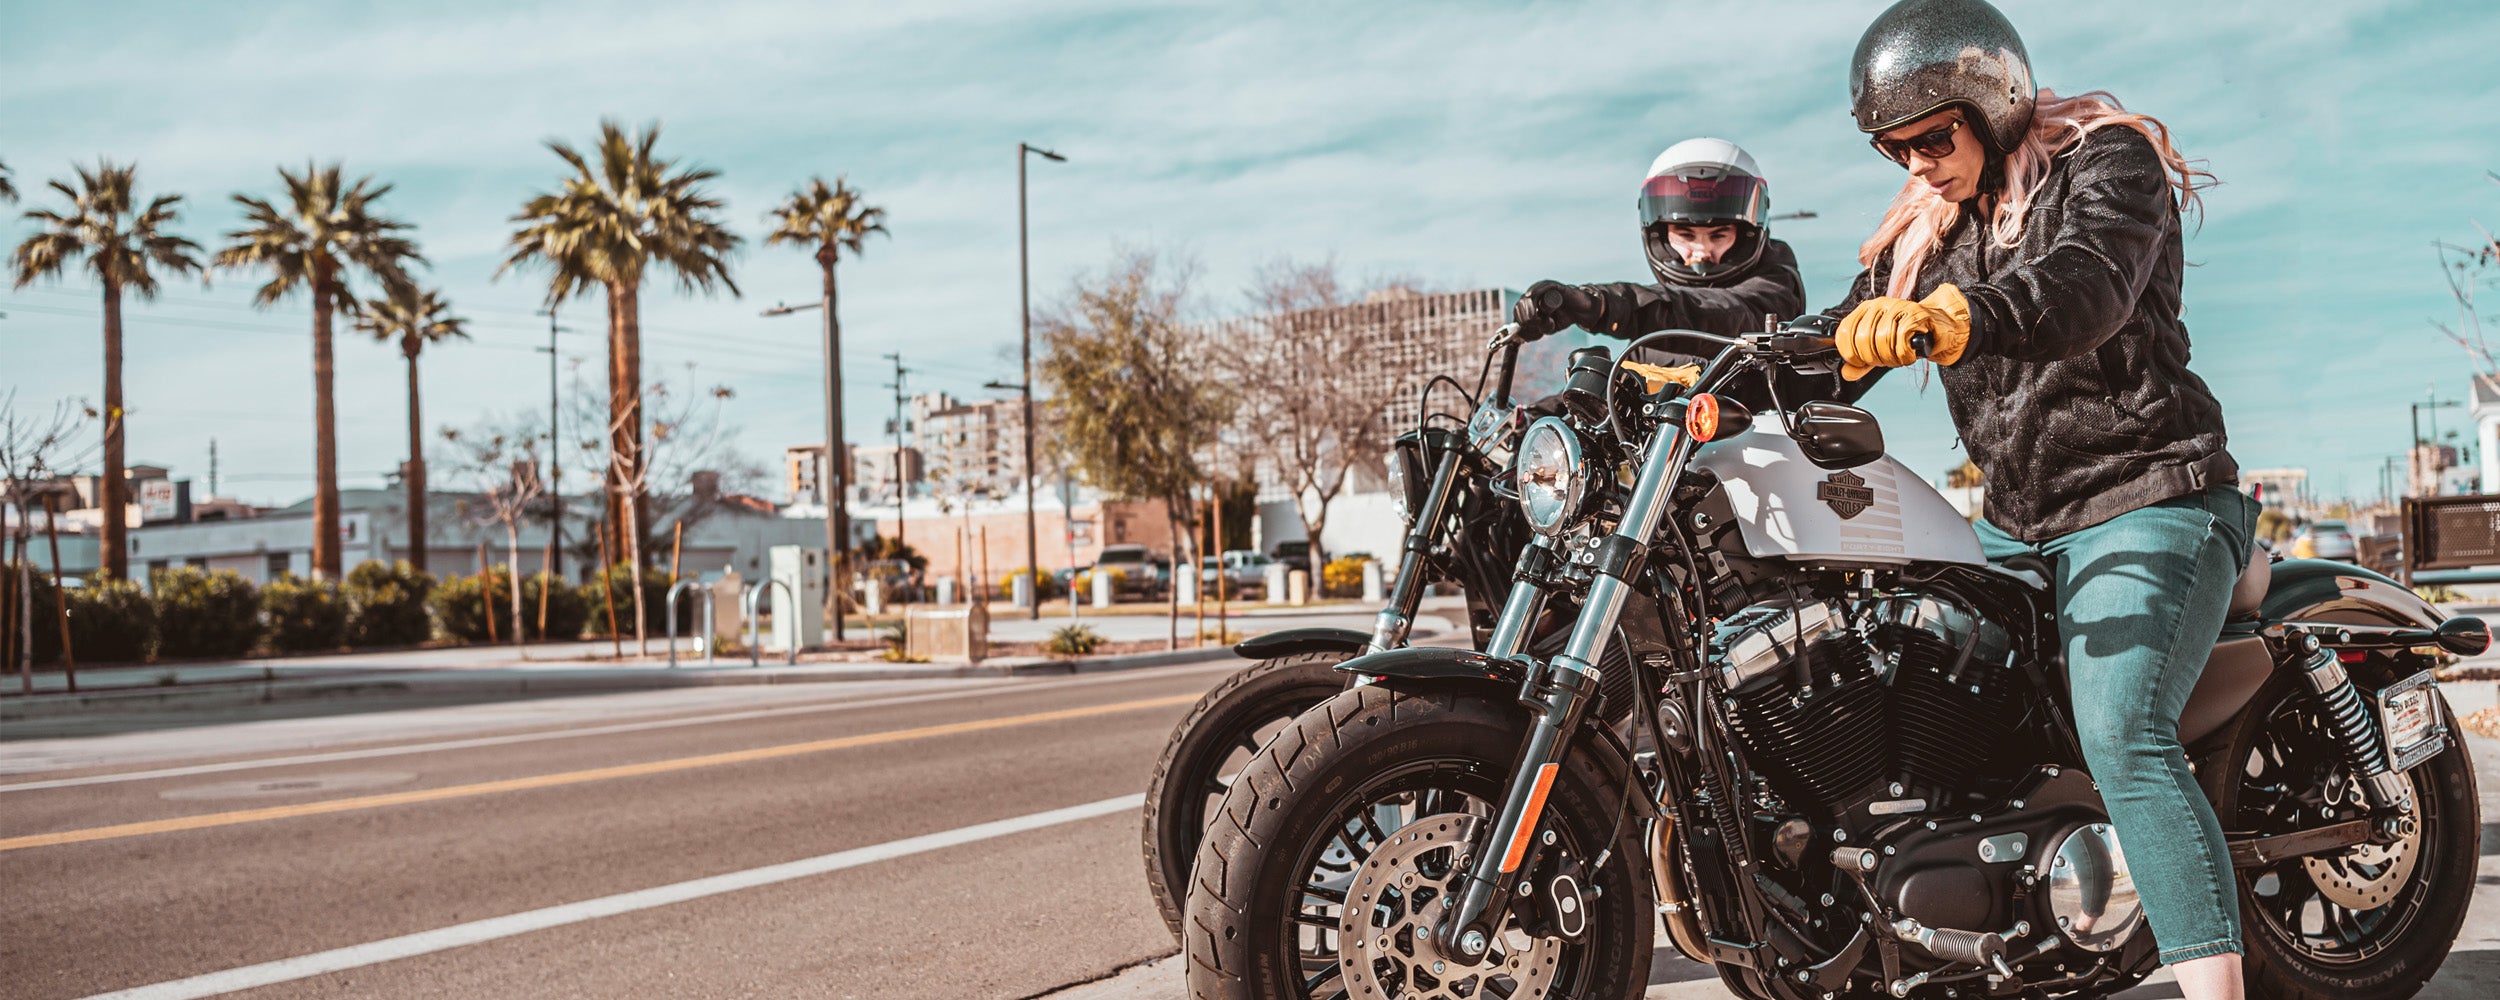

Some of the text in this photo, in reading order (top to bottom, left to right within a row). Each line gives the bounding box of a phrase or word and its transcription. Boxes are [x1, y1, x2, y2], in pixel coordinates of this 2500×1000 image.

[1835, 475, 1862, 486] MOTOR
[1825, 485, 1871, 502] HARLEY-DAVIDSON
[1836, 500, 1862, 514] CYCLES
